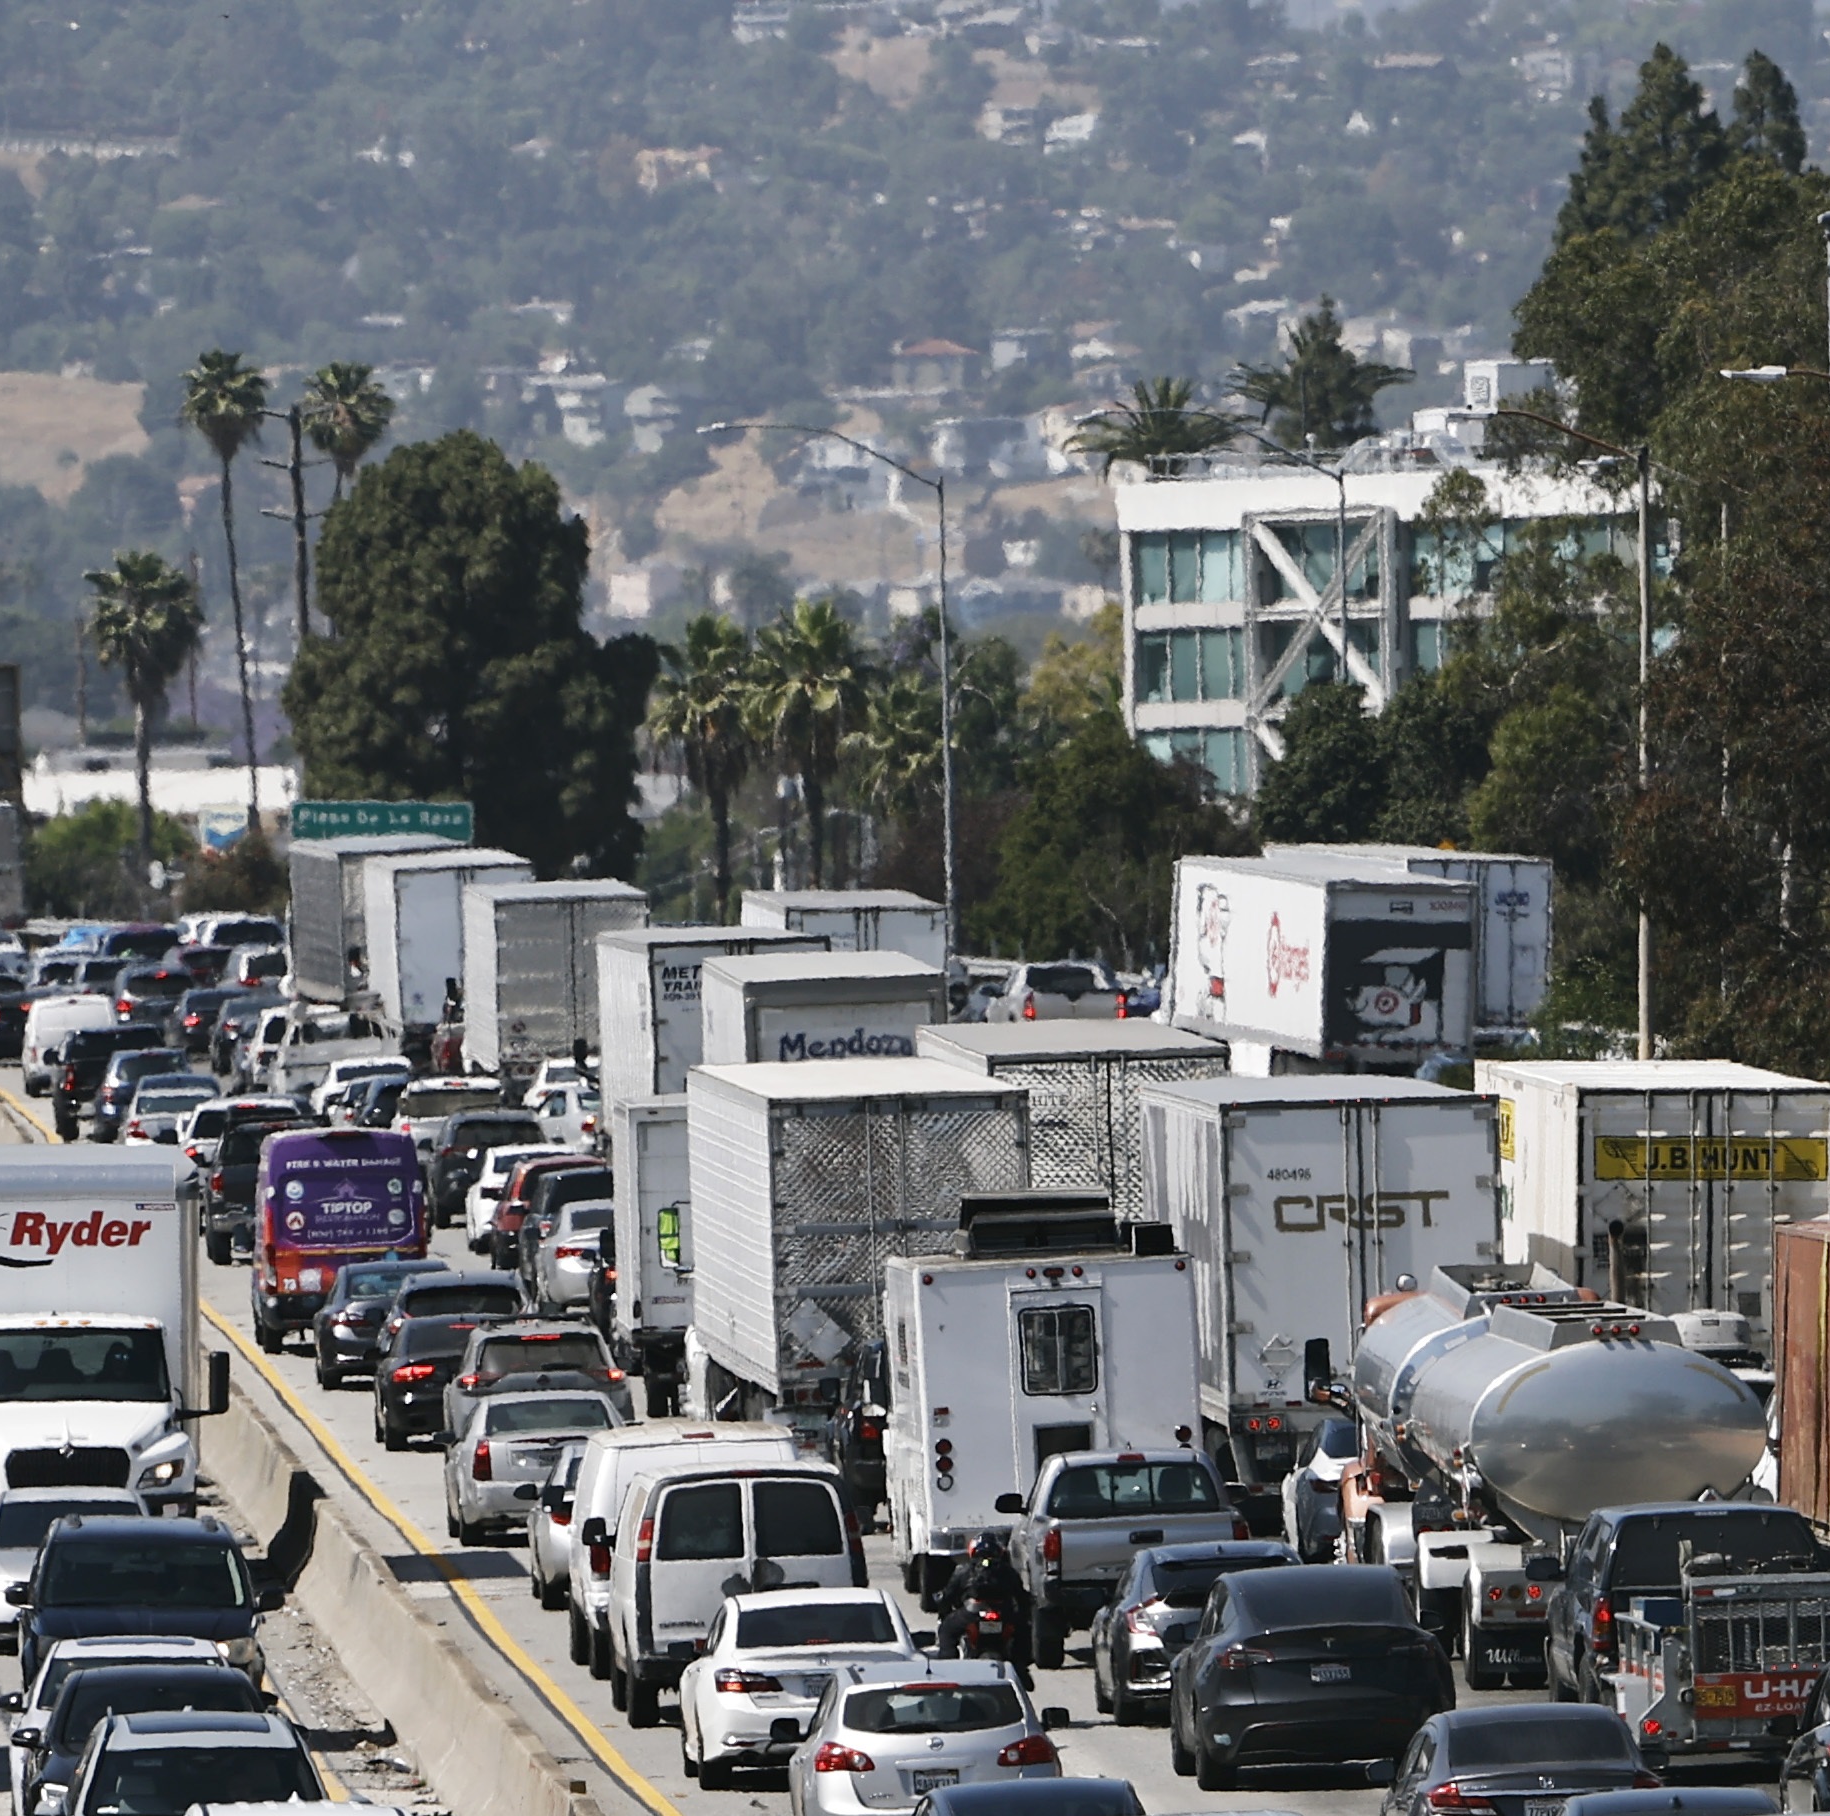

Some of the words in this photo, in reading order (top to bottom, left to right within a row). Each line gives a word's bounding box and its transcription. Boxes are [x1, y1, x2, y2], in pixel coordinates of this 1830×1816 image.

[779, 1027, 915, 1062] Mendoza
[323, 1158, 359, 1168] WATER
[1703, 1148, 1777, 1171] HUNT
[321, 1201, 373, 1215] TIPTOP
[1273, 1191, 1450, 1233] CRST
[10, 1210, 152, 1255] Ryder
